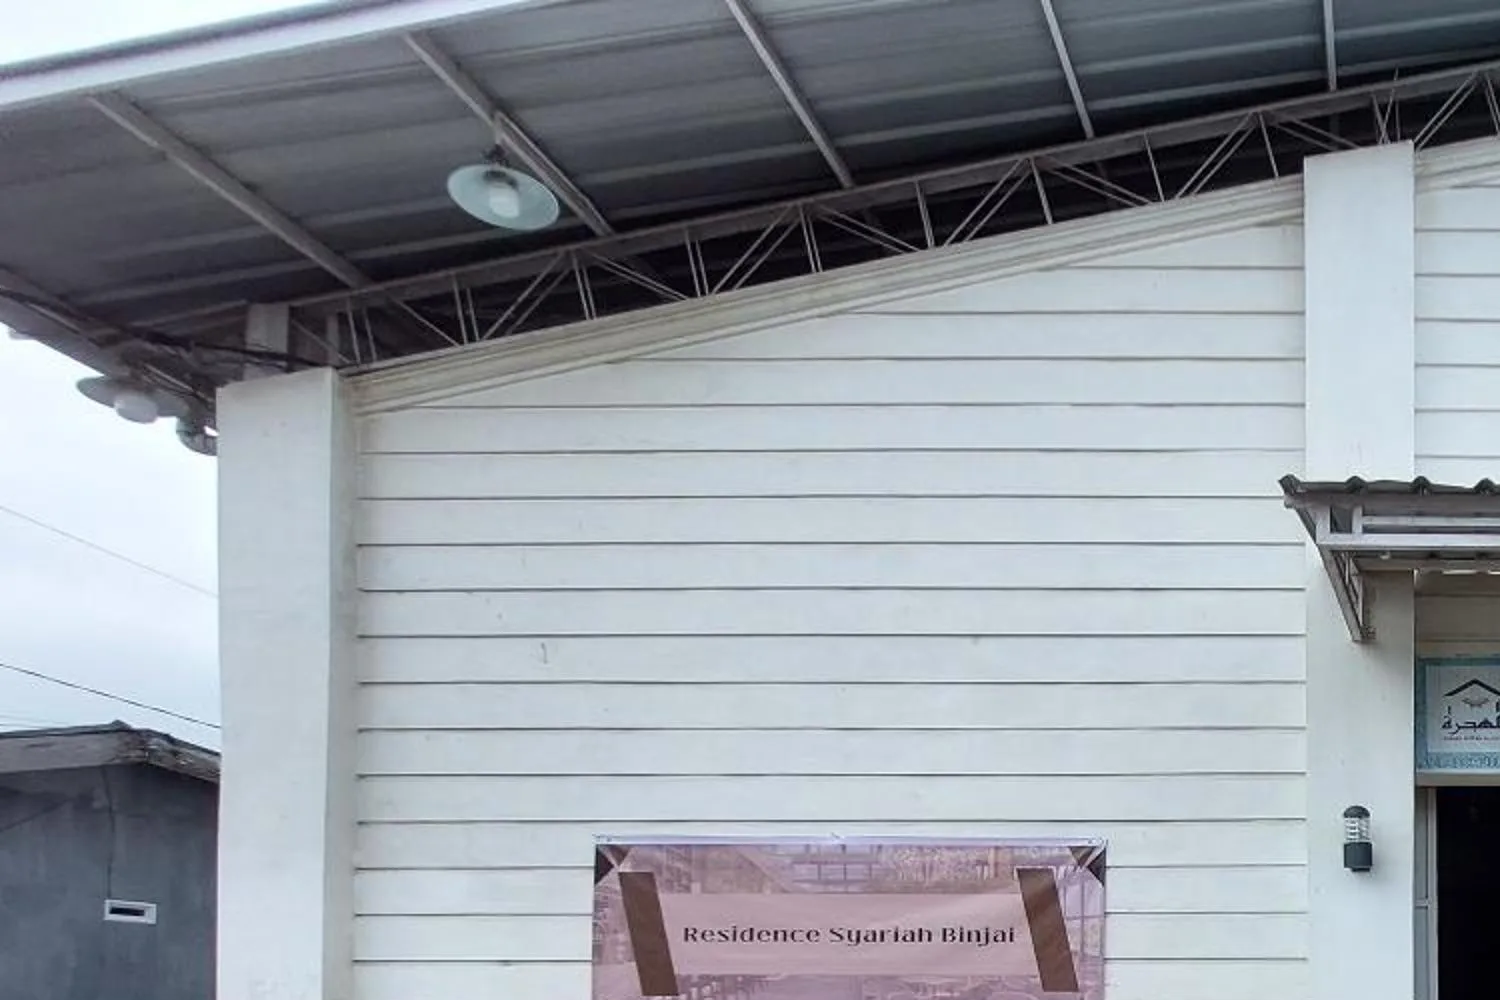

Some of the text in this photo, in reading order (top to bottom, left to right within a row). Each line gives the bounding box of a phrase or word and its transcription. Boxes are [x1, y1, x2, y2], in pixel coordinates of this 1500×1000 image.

[683, 925, 1016, 947] Residence Syariah Binjai
